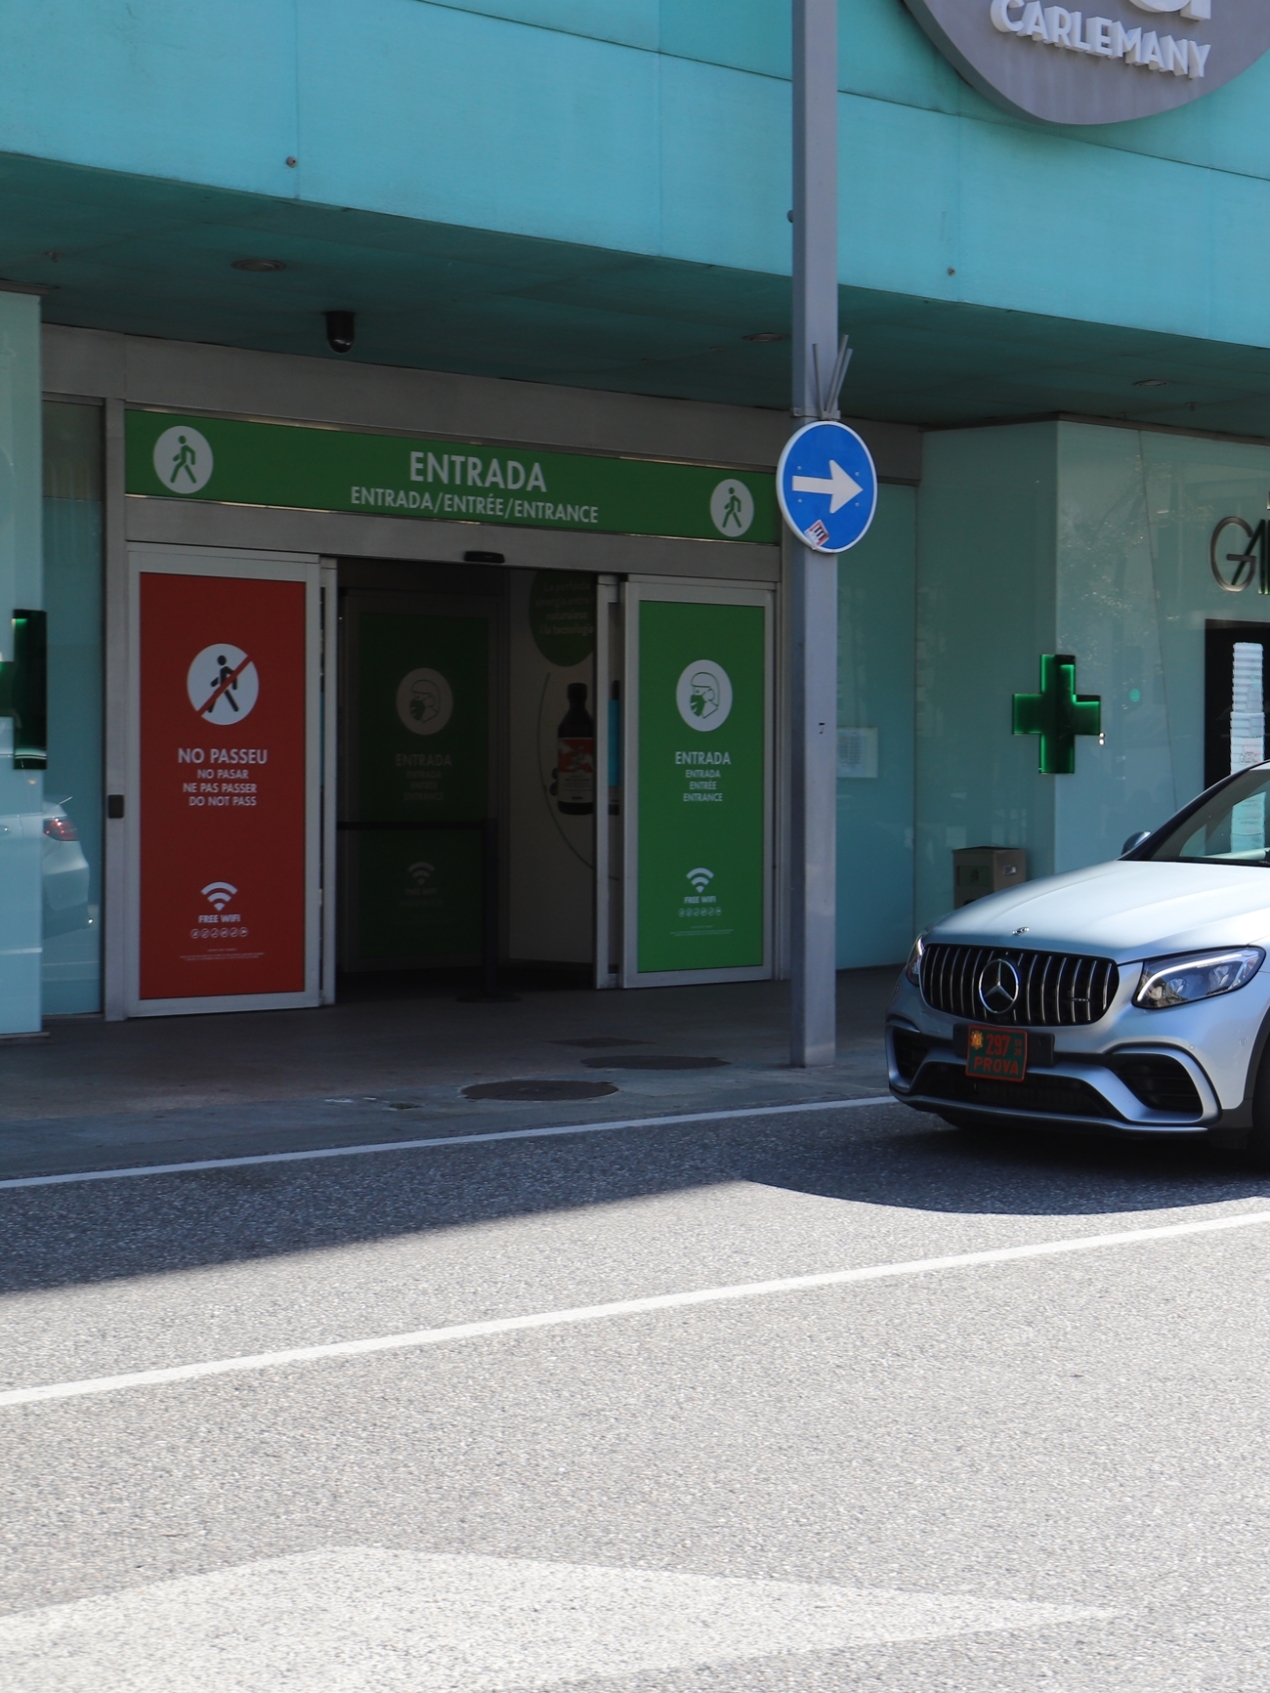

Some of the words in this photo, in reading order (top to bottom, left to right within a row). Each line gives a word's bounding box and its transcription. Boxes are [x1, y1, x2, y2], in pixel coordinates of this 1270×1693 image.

[990, 0, 1212, 79] CARLEMANY
[410, 450, 547, 492] ENTRADA
[351, 486, 598, 523] ENTRADA/ENTRÉE/ENTRANCE
[178, 747, 205, 764] NO
[210, 748, 268, 765] PASSEU
[395, 753, 453, 767] ENTRADA
[675, 751, 732, 765] ENTRADA
[197, 769, 214, 779] NO
[217, 769, 249, 779] PASAR
[685, 769, 721, 778] ENTRADA
[183, 782, 198, 793] NE
[200, 782, 219, 793] PAS
[221, 783, 257, 794] PASSER
[189, 796, 205, 806] DO
[207, 796, 231, 806] NOT
[232, 796, 257, 806] PASS
[683, 793, 724, 802] ENTRANCE
[198, 914, 219, 923] FREE
[220, 913, 241, 923] WIFI
[986, 1033, 1011, 1056] 297
[974, 1056, 1019, 1075] PROVA
